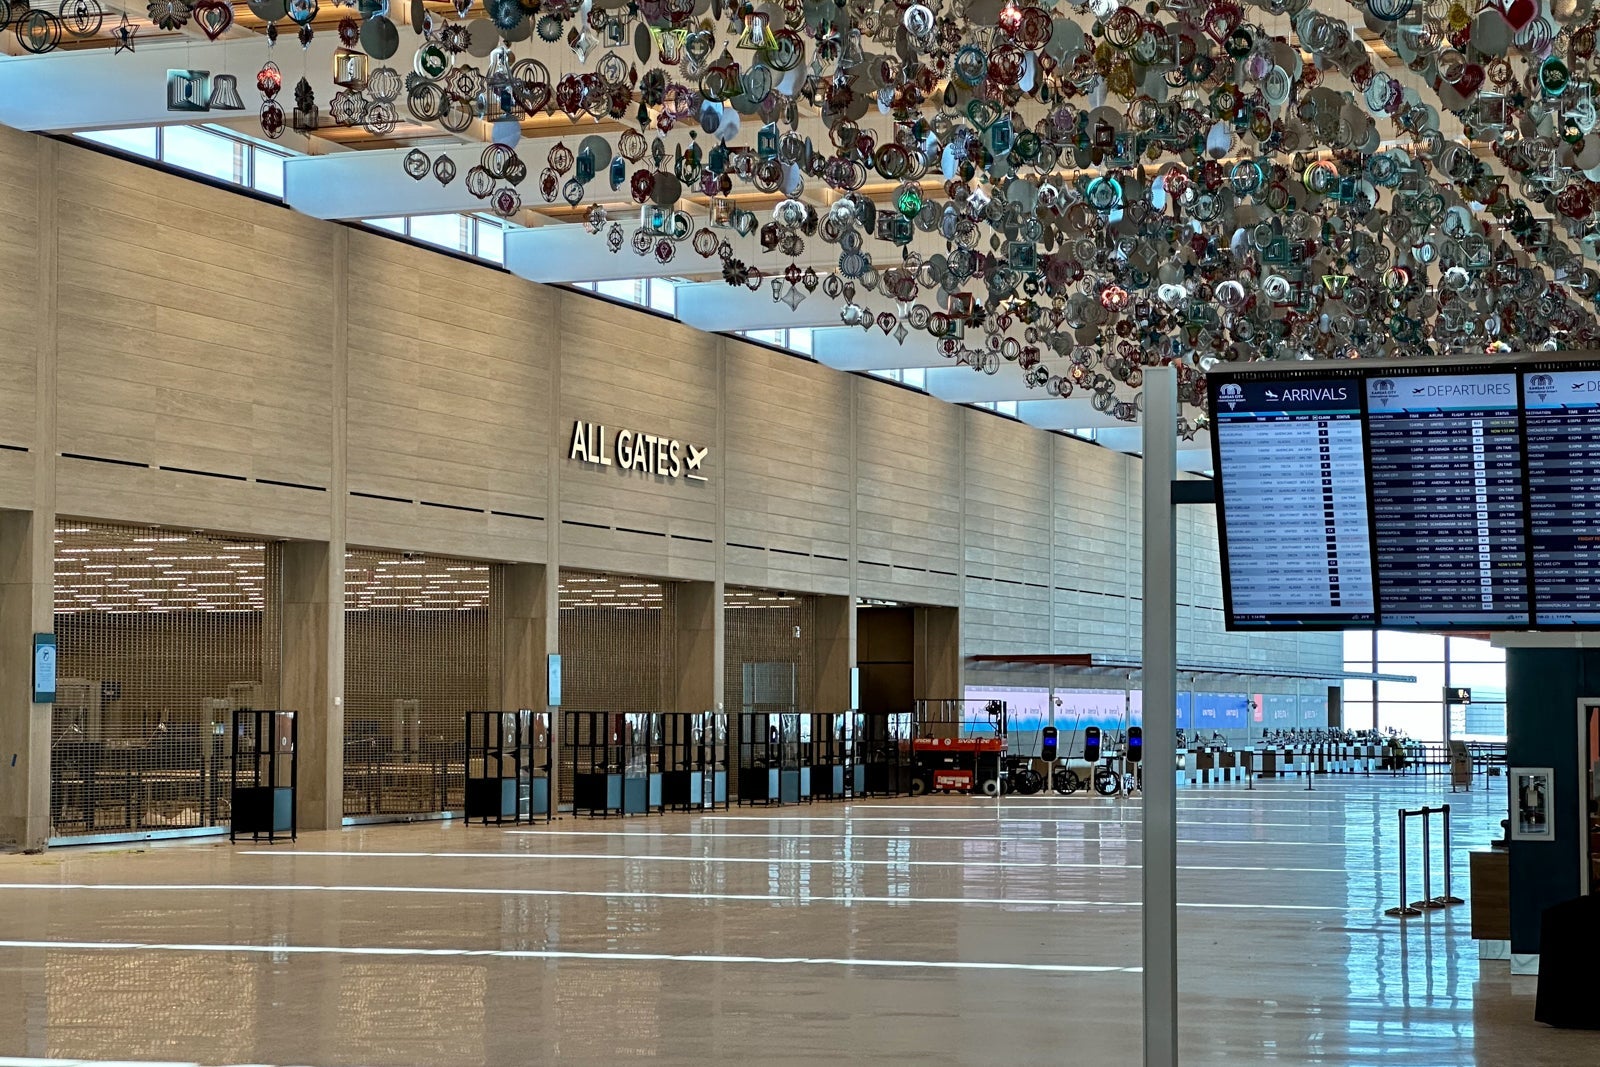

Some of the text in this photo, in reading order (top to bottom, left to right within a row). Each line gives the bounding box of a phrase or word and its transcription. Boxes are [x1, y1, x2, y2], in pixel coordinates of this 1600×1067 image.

[1282, 387, 1347, 401] ARRIVALS
[1427, 383, 1511, 397] DEPARTURES
[570, 420, 680, 478] ALL GATES
